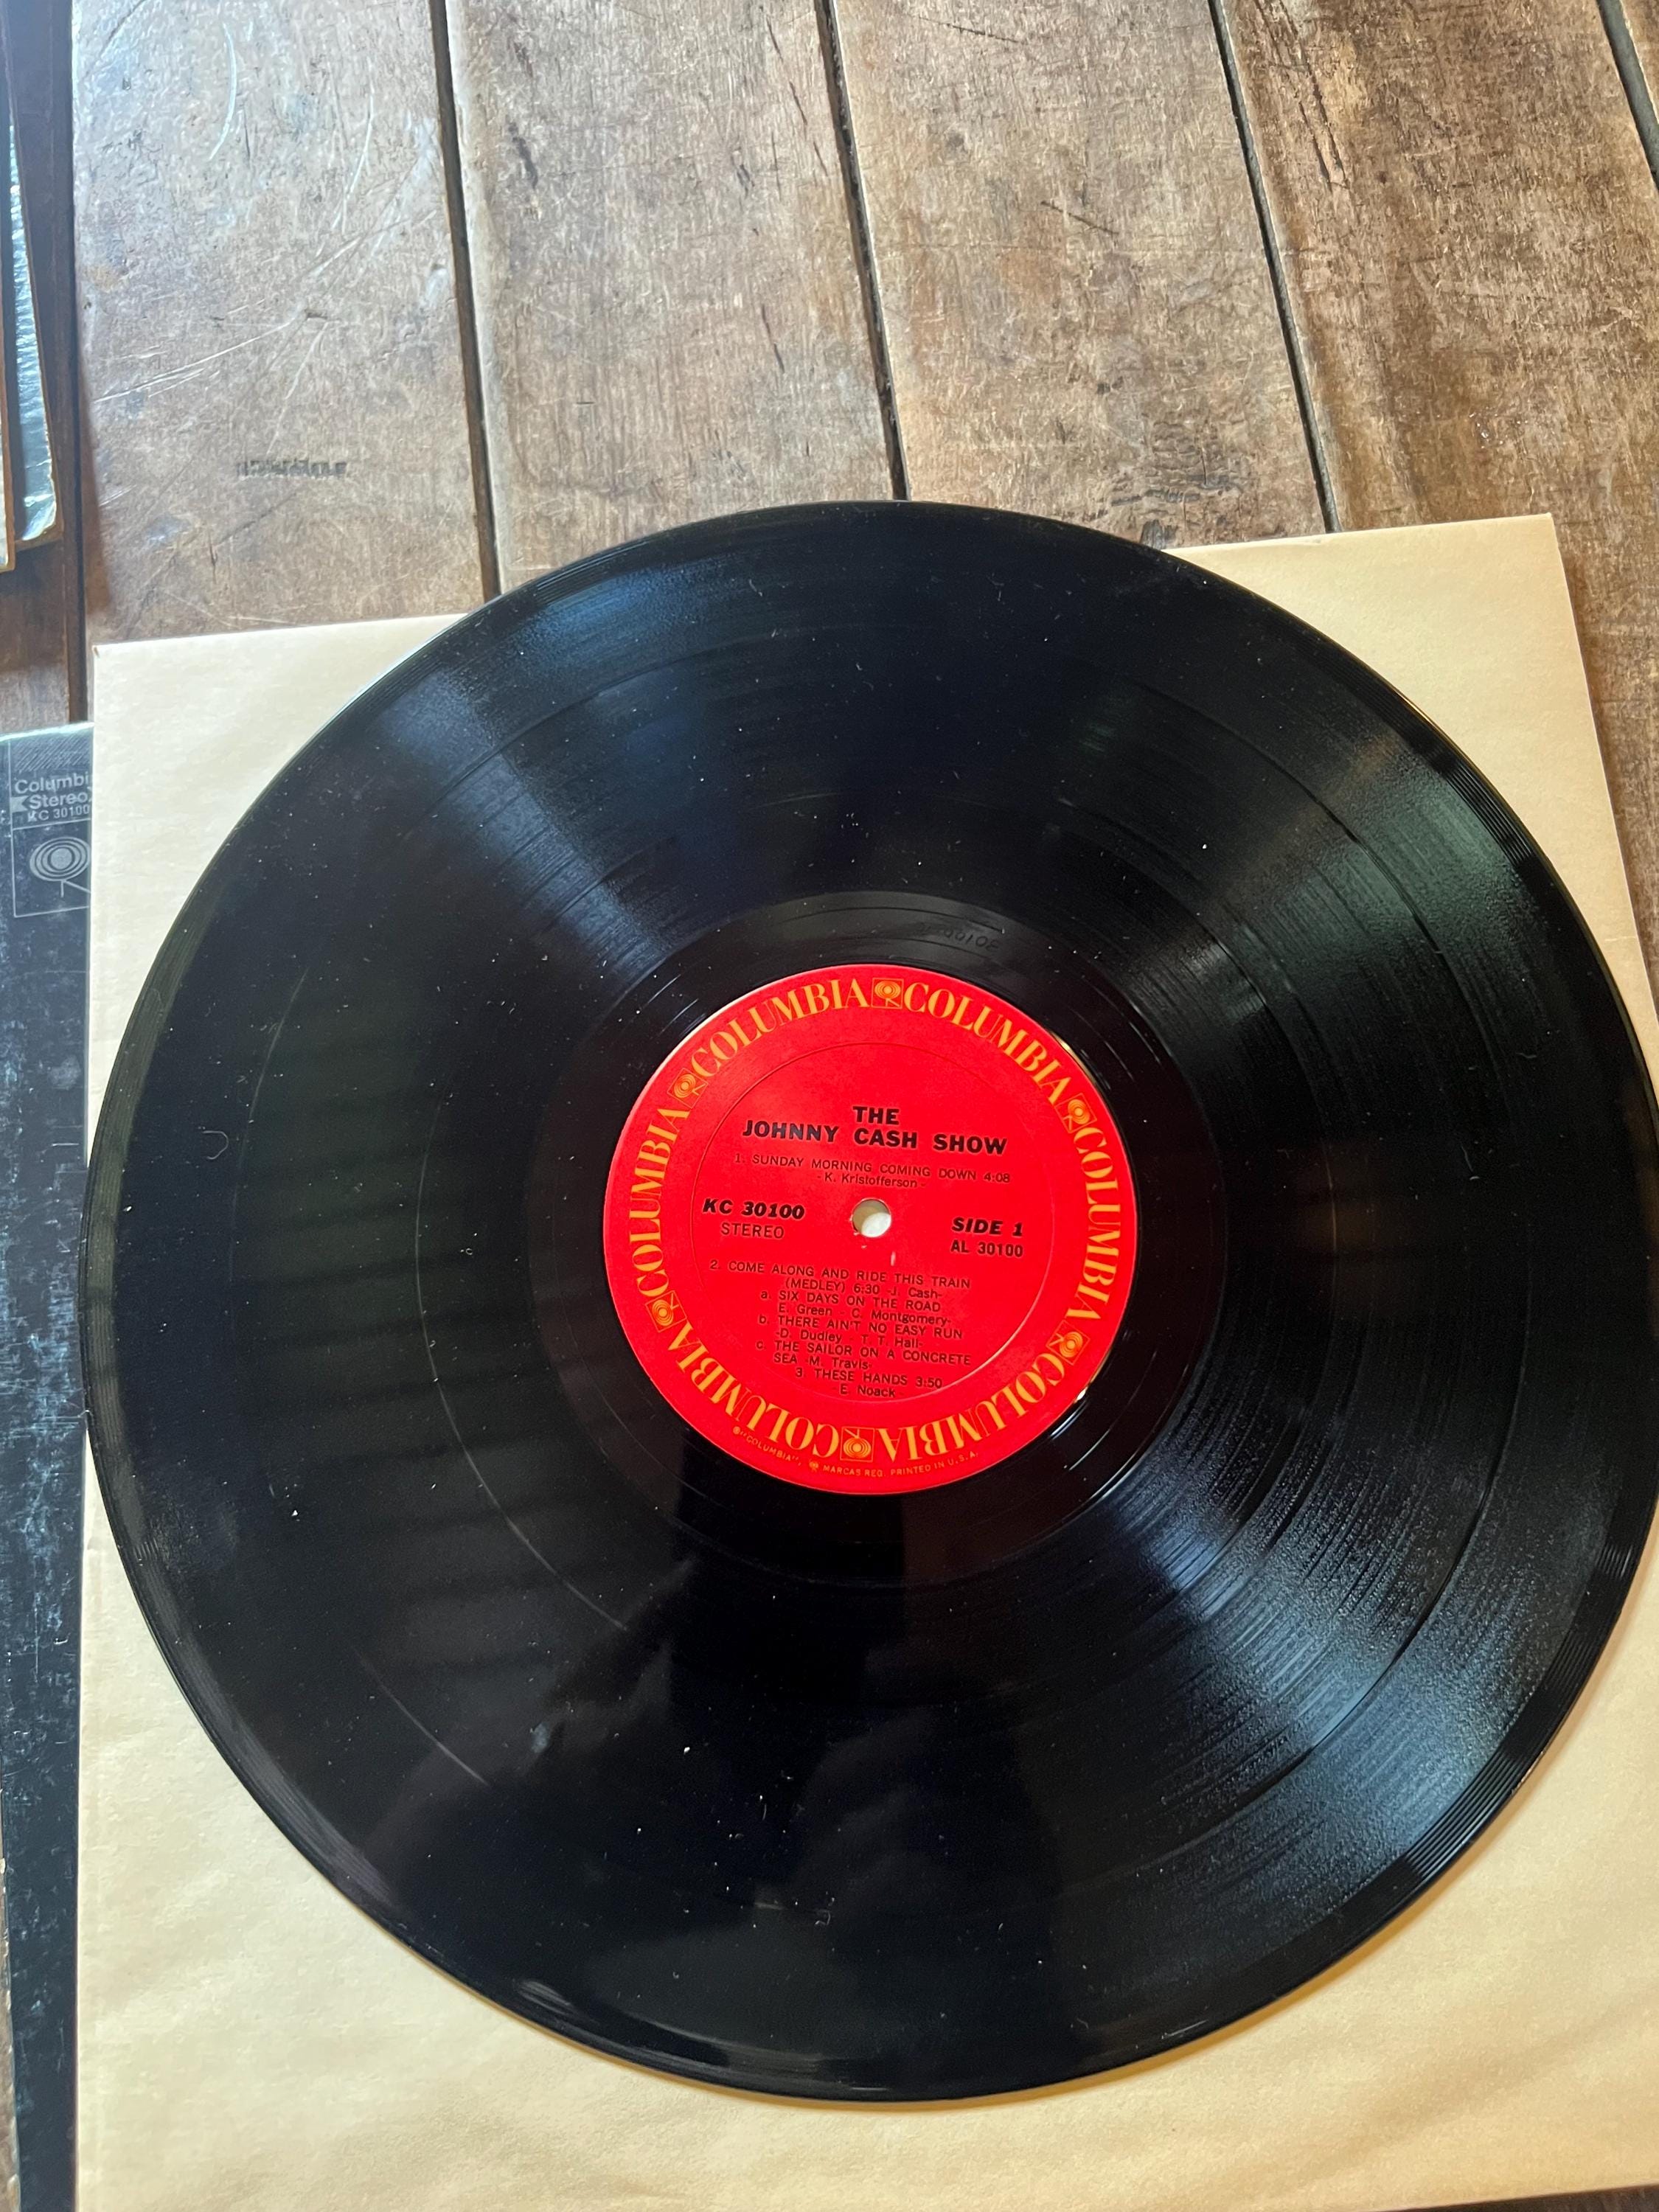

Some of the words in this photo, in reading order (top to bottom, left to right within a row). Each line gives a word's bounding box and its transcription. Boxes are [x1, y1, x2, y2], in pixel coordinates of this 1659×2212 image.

[15, 771, 89, 793] Columbi
[29, 792, 88, 809] Stereo
[28, 810, 49, 822] KC
[53, 804, 90, 818] 30100
[690, 978, 869, 1079] COLUMBIA
[904, 982, 1071, 1105] COLUMBIA
[852, 1106, 900, 1125] THE
[742, 1120, 839, 1142] JOHNNY
[854, 1127, 917, 1148] CASH
[933, 1133, 1007, 1155] SHOW
[734, 1153, 745, 1164] 1.
[752, 1154, 804, 1167] SUNDAY
[811, 1158, 872, 1172] MORNING
[880, 1164, 931, 1177] COMING
[939, 1168, 977, 1180] DOWN
[984, 1172, 1011, 1183] 4:08
[824, 1172, 836, 1182] K.
[842, 1174, 918, 1188] Kristofferson
[629, 1108, 690, 1297] COLUMBIA
[703, 1198, 733, 1214] KC
[742, 1200, 805, 1220] 30100
[721, 1222, 785, 1239] STEREO
[951, 1217, 1004, 1235] SIDE
[1012, 1222, 1023, 1237] 1
[1065, 1127, 1121, 1319] COLUMBIA
[950, 1239, 970, 1253] AL
[977, 1242, 1023, 1258] 30100
[709, 1259, 720, 1270] 2.
[728, 1260, 765, 1273] COME
[772, 1264, 815, 1277] ALONG
[821, 1267, 849, 1279] AND
[857, 1270, 887, 1282] RIDE
[894, 1273, 924, 1285] THIS
[932, 1276, 970, 1289] TRAIN
[785, 1277, 846, 1293] (MEDLEY)
[853, 1283, 880, 1295] 6:30
[760, 1290, 772, 1299] a.
[779, 1290, 799, 1301] SIX
[807, 1293, 839, 1304] DAYS
[846, 1295, 865, 1307] ON
[873, 1297, 898, 1309] THE
[905, 1299, 941, 1312] ROAD
[779, 1302, 790, 1313] E.
[797, 1304, 833, 1316] Green
[852, 1307, 863, 1319] C.
[759, 1314, 771, 1325] b.
[778, 1315, 821, 1328] THERE
[827, 1318, 861, 1331] AIN'T
[869, 1322, 888, 1334] NO
[894, 1324, 927, 1336] EASY
[933, 1327, 963, 1339] RUN
[800, 1329, 842, 1344] Dudley
[861, 1334, 872, 1345] T.
[877, 1335, 888, 1346] T.
[773, 1352, 798, 1364] SEA
[774, 1340, 800, 1352] THE
[807, 1343, 852, 1356] SAILOR
[860, 1347, 879, 1358] ON
[886, 1349, 896, 1360] A
[902, 1349, 972, 1366] CONCRETE
[796, 1367, 807, 1378] 3.
[814, 1368, 855, 1382] THESE
[863, 1373, 908, 1386] HANDS
[916, 1376, 943, 1389] 3:50
[668, 1321, 839, 1458] COLUMBIA
[857, 1385, 896, 1398] Noack
[877, 1353, 1065, 1461] COLUMBIA
[823, 1464, 861, 1475] MARCAS
[890, 1464, 931, 1475] PRINTED
[933, 1461, 945, 1470] IN
[947, 1450, 978, 1467] U.S.A.
